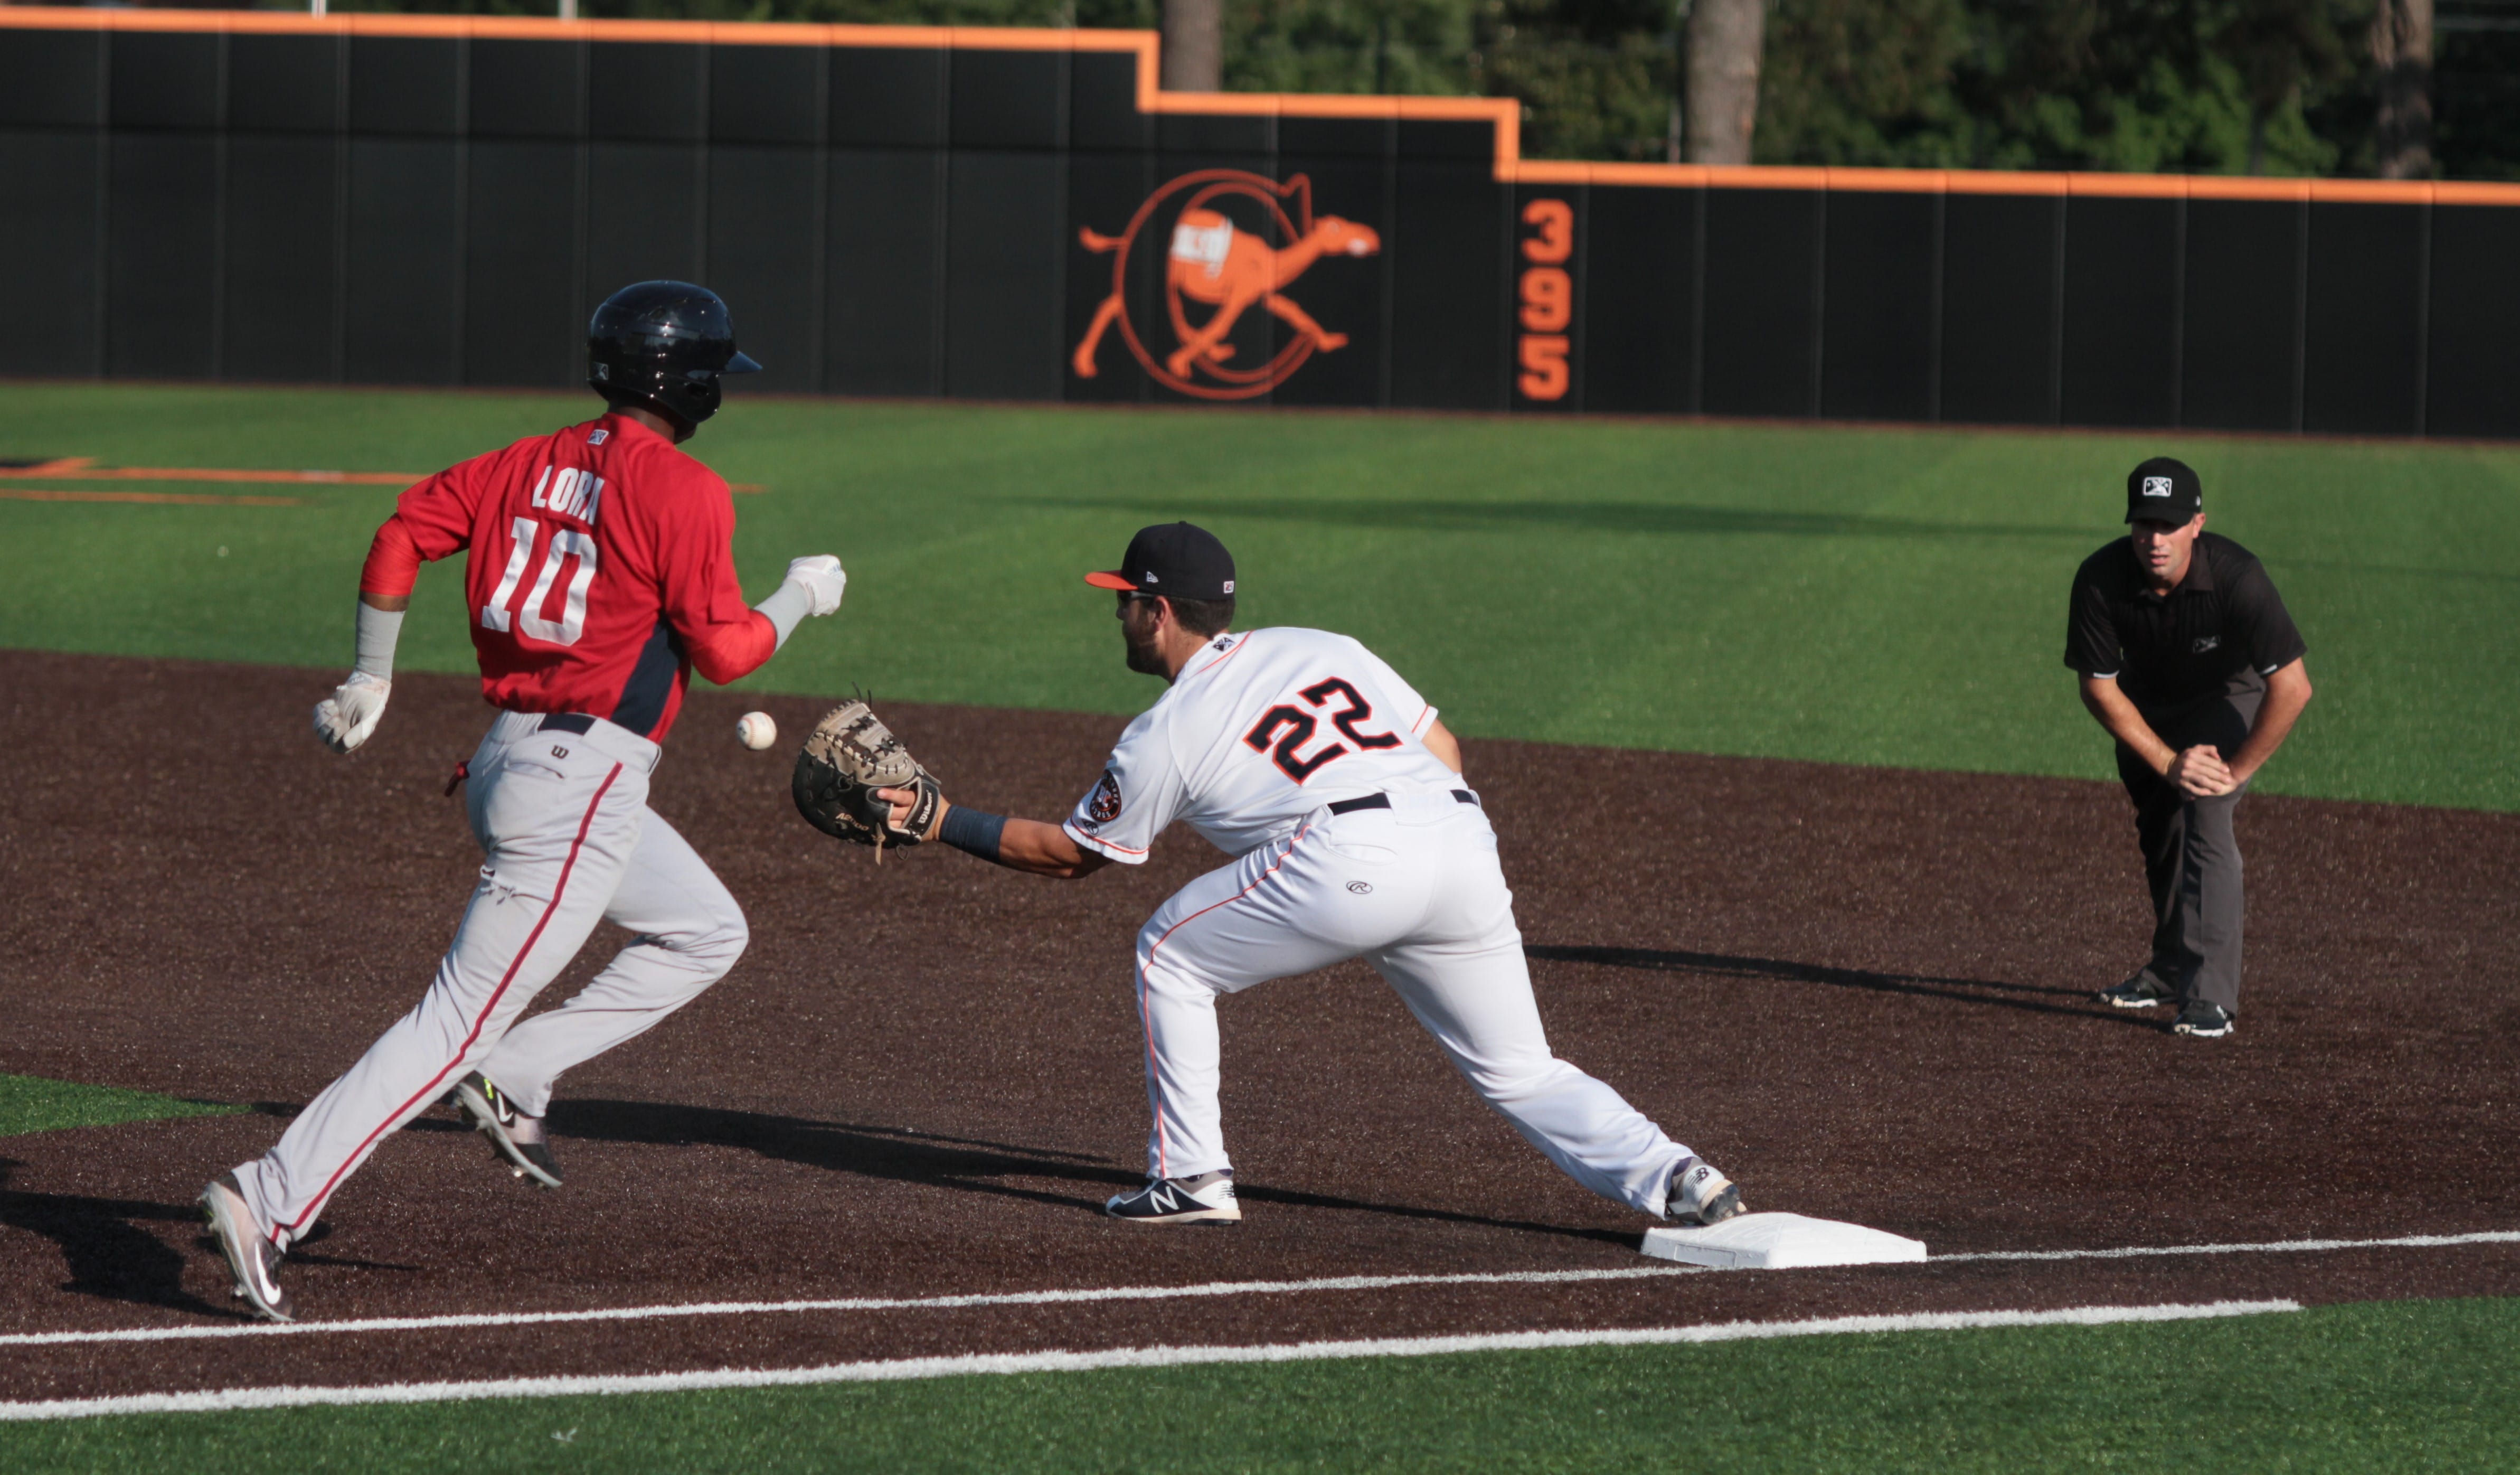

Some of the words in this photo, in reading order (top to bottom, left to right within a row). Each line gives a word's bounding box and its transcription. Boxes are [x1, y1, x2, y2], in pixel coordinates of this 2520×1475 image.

[1517, 199, 1574, 400] 395
[532, 465, 605, 525] LORA
[482, 516, 597, 646] 10
[1242, 675, 1403, 786] 22
[1150, 1186, 1179, 1214] N
